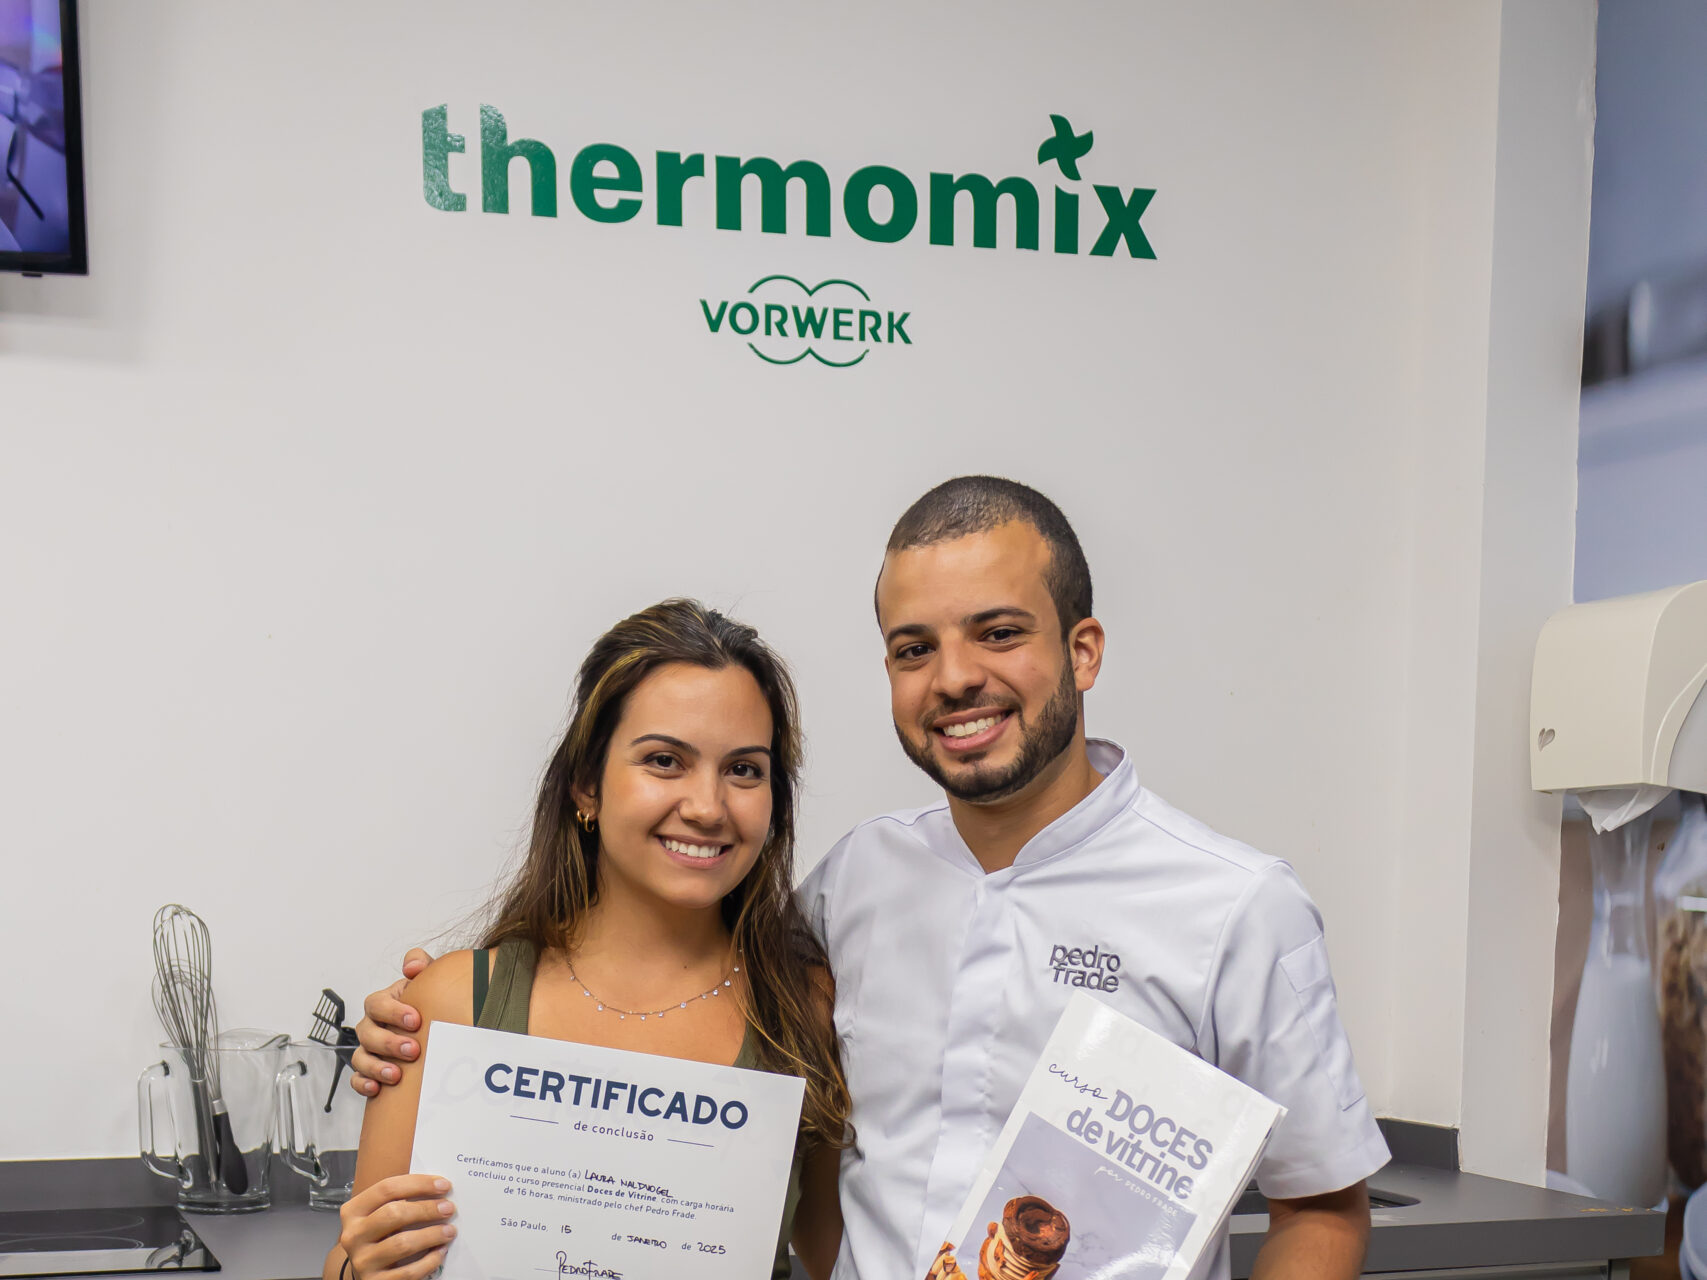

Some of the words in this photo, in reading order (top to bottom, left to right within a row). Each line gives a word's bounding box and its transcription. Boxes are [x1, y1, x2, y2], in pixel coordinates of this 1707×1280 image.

[422, 104, 1157, 261] thermomix
[699, 298, 913, 345] VORWERK
[1049, 944, 1121, 972] pedro
[1053, 961, 1119, 993] frade
[484, 1063, 749, 1130] CERTIFICADO
[573, 1120, 588, 1132] de
[592, 1124, 655, 1141] conclusão
[1048, 1063, 1109, 1100] curso
[1105, 1089, 1213, 1170] DOCES
[456, 1153, 513, 1170] Certificamos
[515, 1163, 532, 1173] que
[541, 1167, 566, 1177] aluno
[568, 1169, 581, 1179] (a)
[1066, 1106, 1104, 1145] de
[1105, 1130, 1194, 1200] vitrine
[468, 1169, 506, 1181] concluiu
[516, 1177, 540, 1186] curso
[541, 1180, 585, 1192] presencial
[587, 1185, 613, 1196] Doces
[615, 1189, 625, 1198] de
[660, 1197, 679, 1205] com
[680, 1200, 703, 1210] carga
[503, 1186, 514, 1195] de
[517, 1187, 527, 1196] 16
[557, 1193, 603, 1207] ministrado
[604, 1200, 622, 1210] pelo
[624, 1203, 644, 1212] chef
[646, 1205, 670, 1216] Pedro
[500, 1217, 518, 1228] São
[611, 1232, 622, 1241] de
[681, 1241, 692, 1251] de
[697, 1241, 726, 1255] 2025
